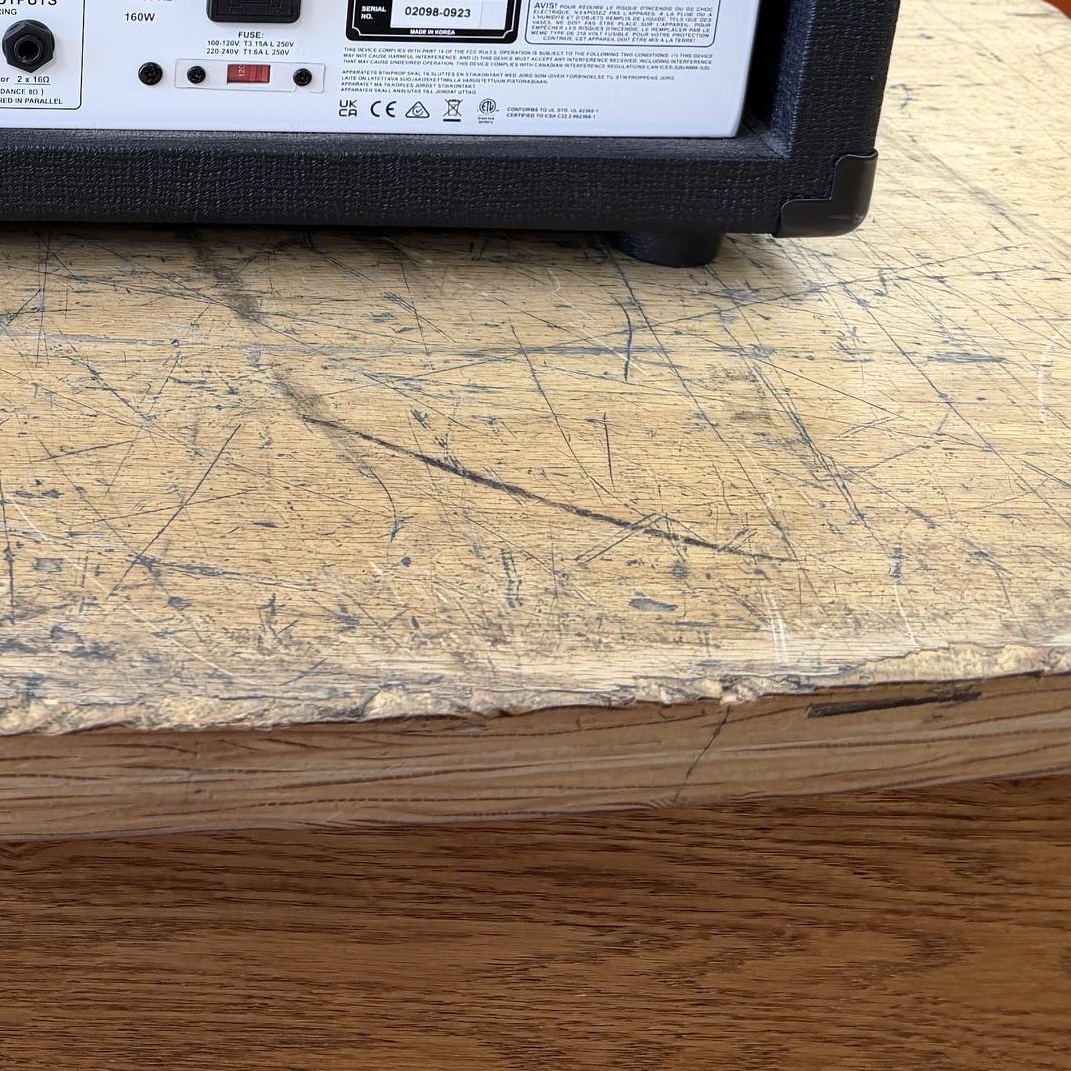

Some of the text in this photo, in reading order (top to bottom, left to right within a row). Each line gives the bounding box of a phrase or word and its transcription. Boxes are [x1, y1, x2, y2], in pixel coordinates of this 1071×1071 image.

[405, 6, 471, 18] 02098-0923
[124, 12, 156, 21] 160W
[238, 31, 264, 39] FUSE:
[25, 97, 63, 105] PARALLEL
[339, 109, 357, 117] CA
